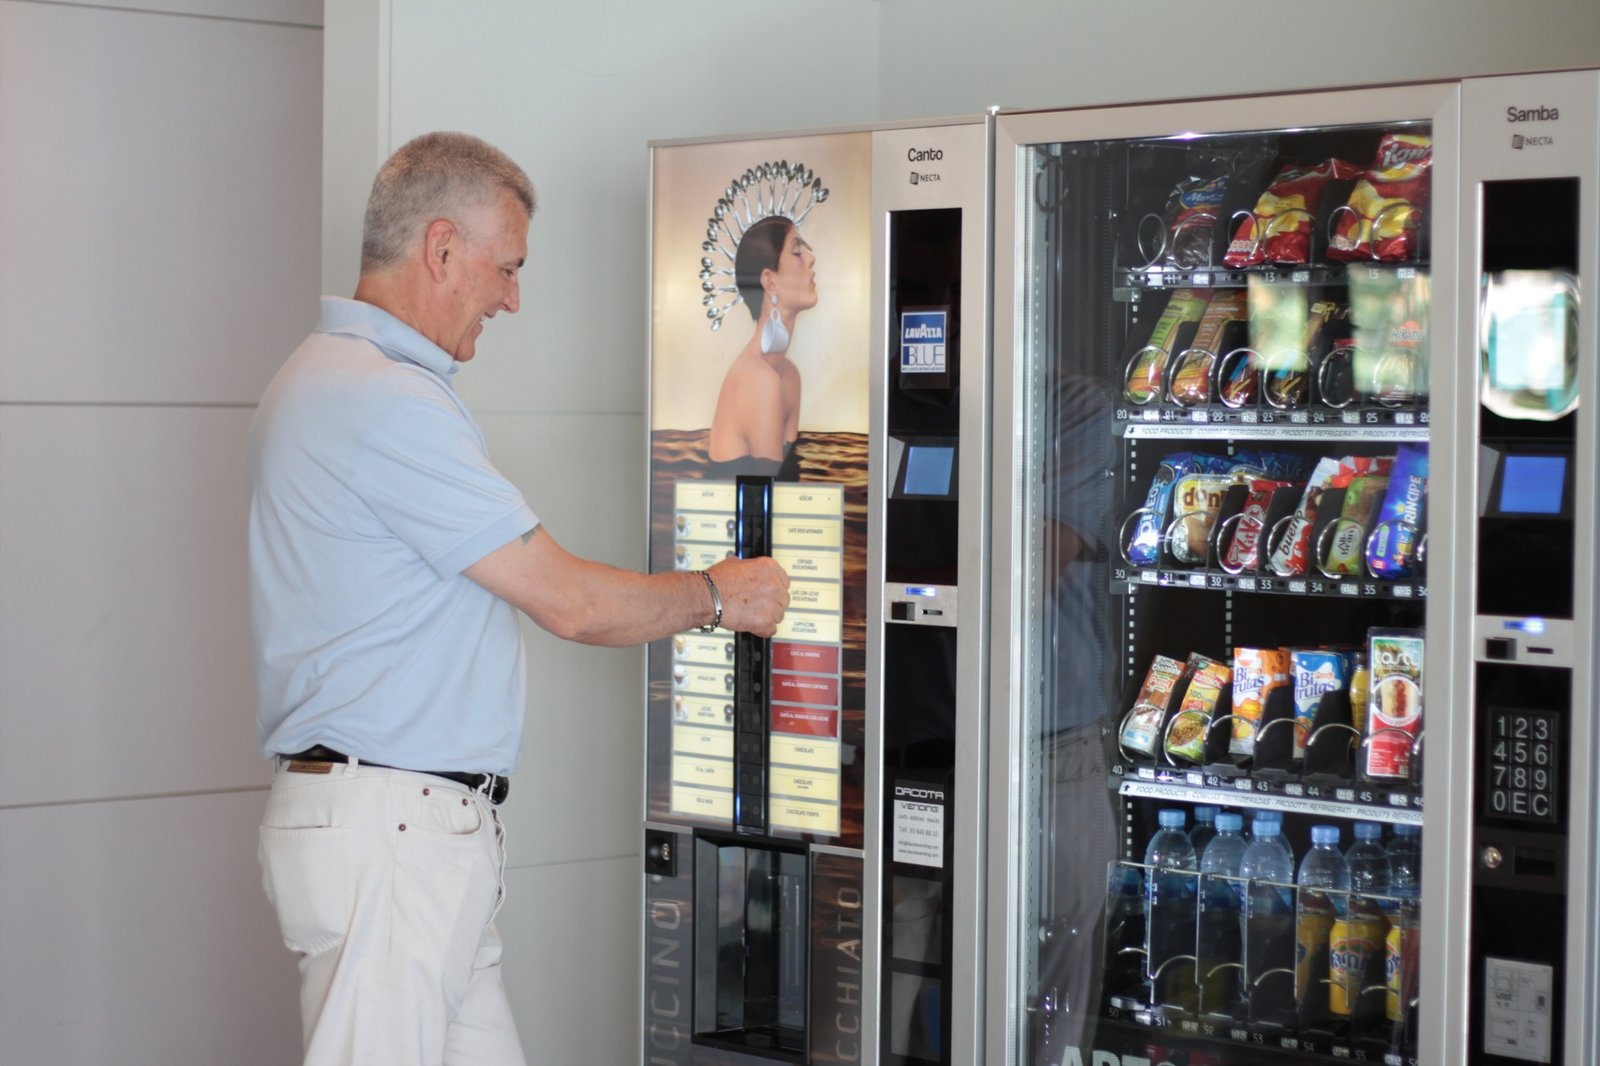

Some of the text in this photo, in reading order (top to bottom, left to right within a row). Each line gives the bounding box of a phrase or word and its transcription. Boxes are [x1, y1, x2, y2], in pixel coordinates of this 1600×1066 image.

[1506, 105, 1558, 122] Samba
[1525, 137, 1553, 146] NECTA
[908, 148, 943, 162] Canto
[1264, 272, 1274, 282] 13
[1368, 269, 1378, 280] 15
[905, 324, 942, 338] LAVAZZA
[903, 345, 944, 366] BLUE
[1116, 410, 1127, 419] 20
[1213, 412, 1223, 421] 22
[1263, 412, 1273, 422] 23
[1314, 413, 1324, 422] 24
[1366, 413, 1378, 423] 25
[1115, 570, 1125, 579] 30
[1211, 577, 1222, 586] 32
[1261, 580, 1272, 590] 33
[1312, 583, 1322, 592] 34
[1364, 585, 1376, 595] 35
[1236, 667, 1247, 683] Bi
[1300, 672, 1314, 688] Bi
[1497, 716, 1548, 740] 1 2 3
[1494, 741, 1547, 765] 4 5 6
[1113, 765, 1123, 774] 40
[1207, 776, 1218, 786] 42
[1494, 766, 1547, 790] 7 8 9
[1257, 782, 1268, 791] 43
[1308, 787, 1319, 796] 44
[895, 786, 944, 800] DACOTA
[1360, 792, 1372, 802] 45
[1494, 791, 1548, 816] 0 E C
[1253, 1034, 1263, 1044] 53
[1303, 1041, 1314, 1052] 54
[1355, 1050, 1366, 1060] 55
